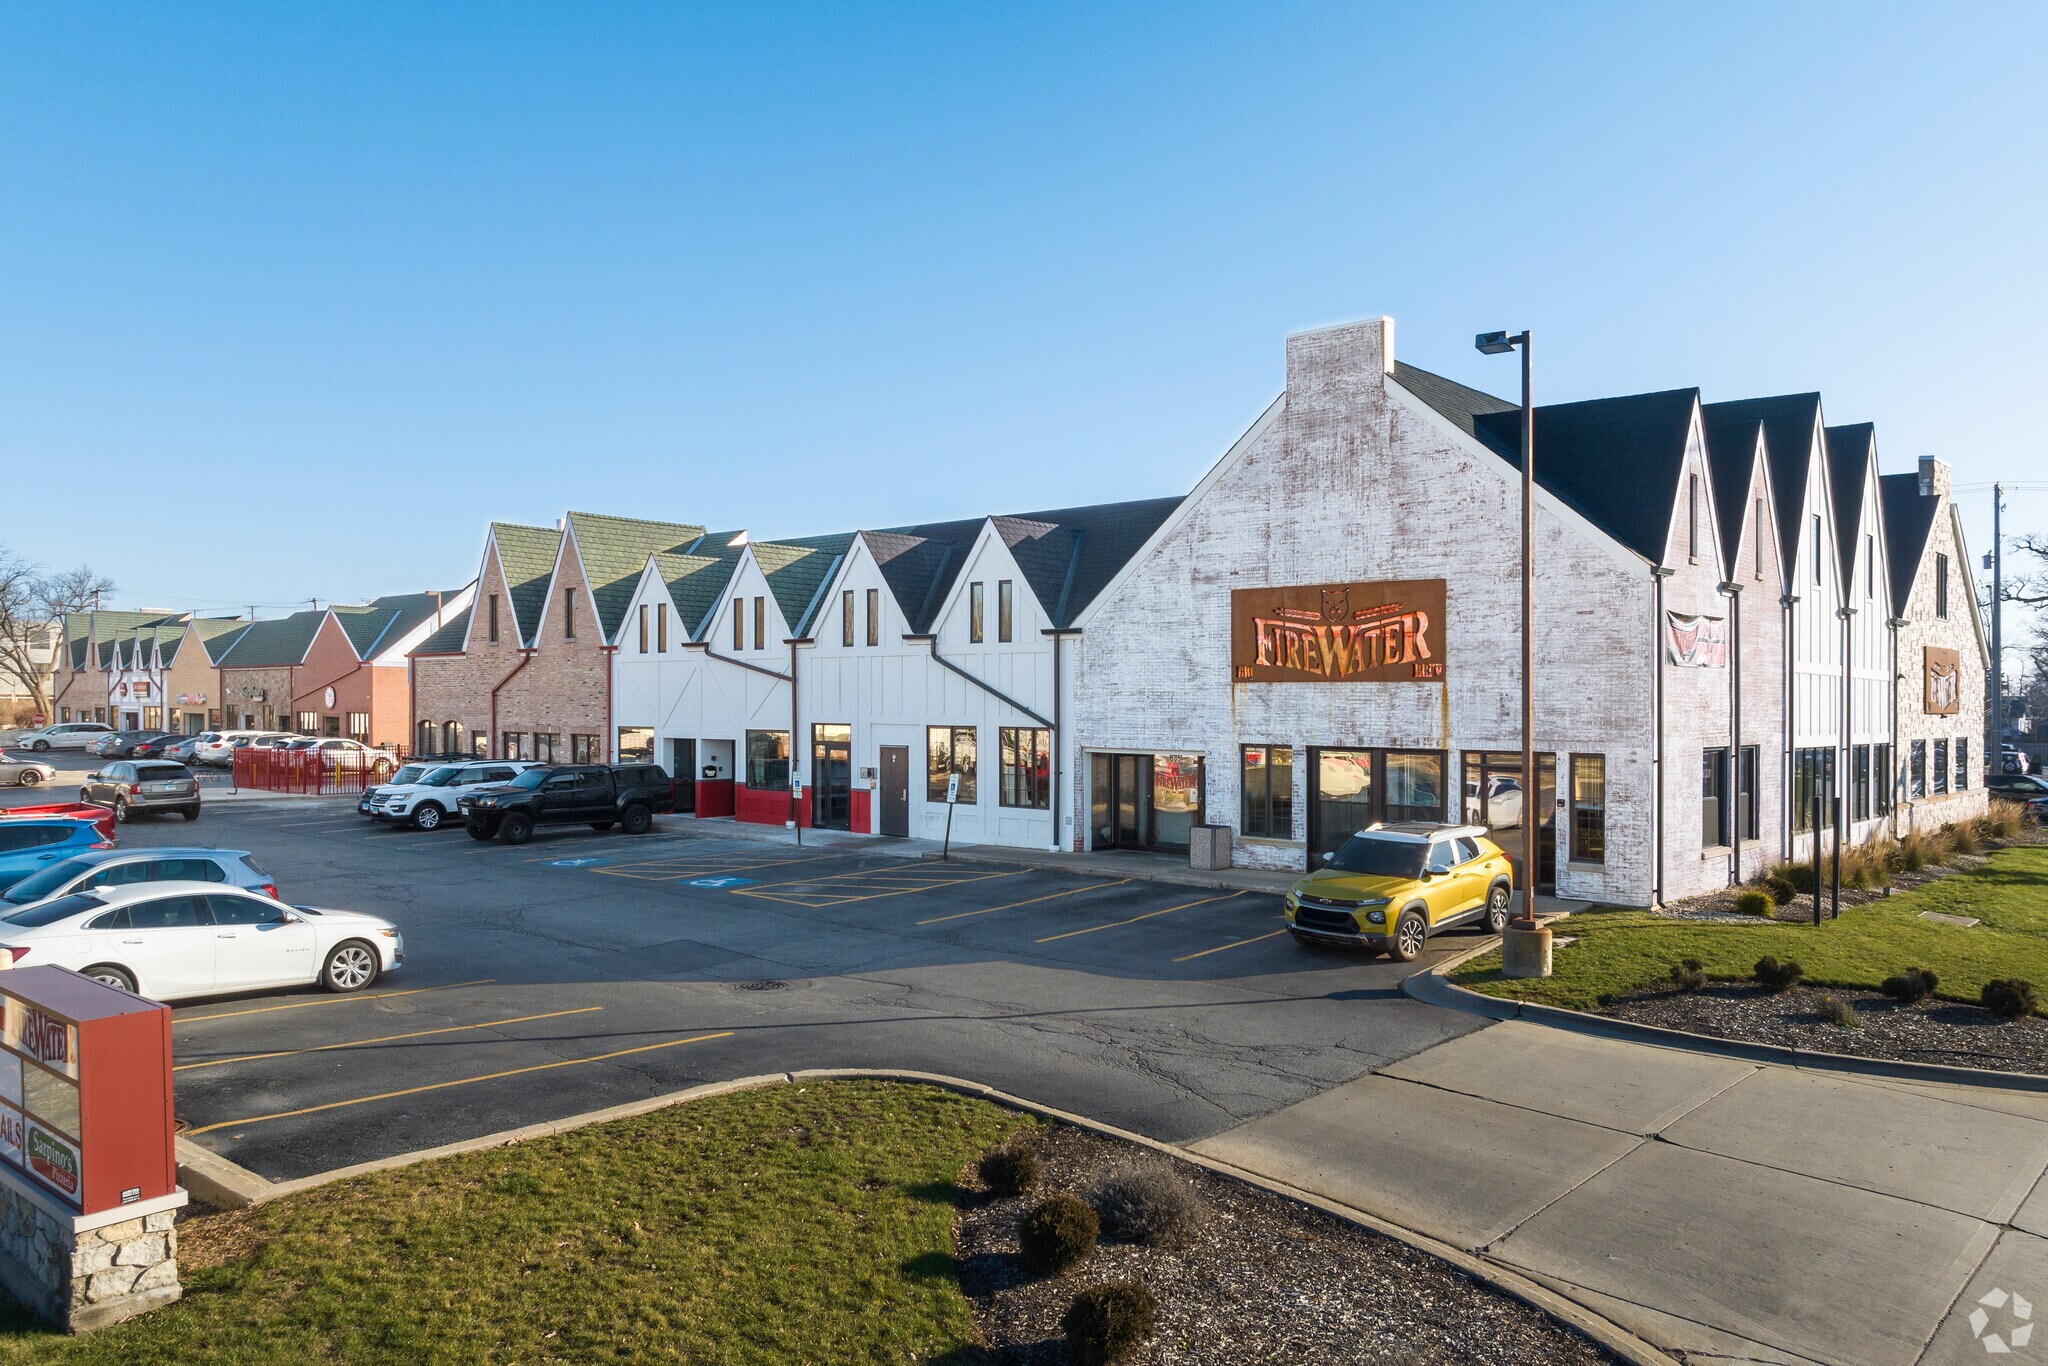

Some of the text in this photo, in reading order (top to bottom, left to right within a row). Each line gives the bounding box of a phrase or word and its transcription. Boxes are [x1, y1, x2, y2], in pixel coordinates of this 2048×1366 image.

[1253, 611, 1432, 679] FIREWATER
[33, 1131, 73, 1173] Sarpino's
[52, 1166, 74, 1190] Pizzeria
